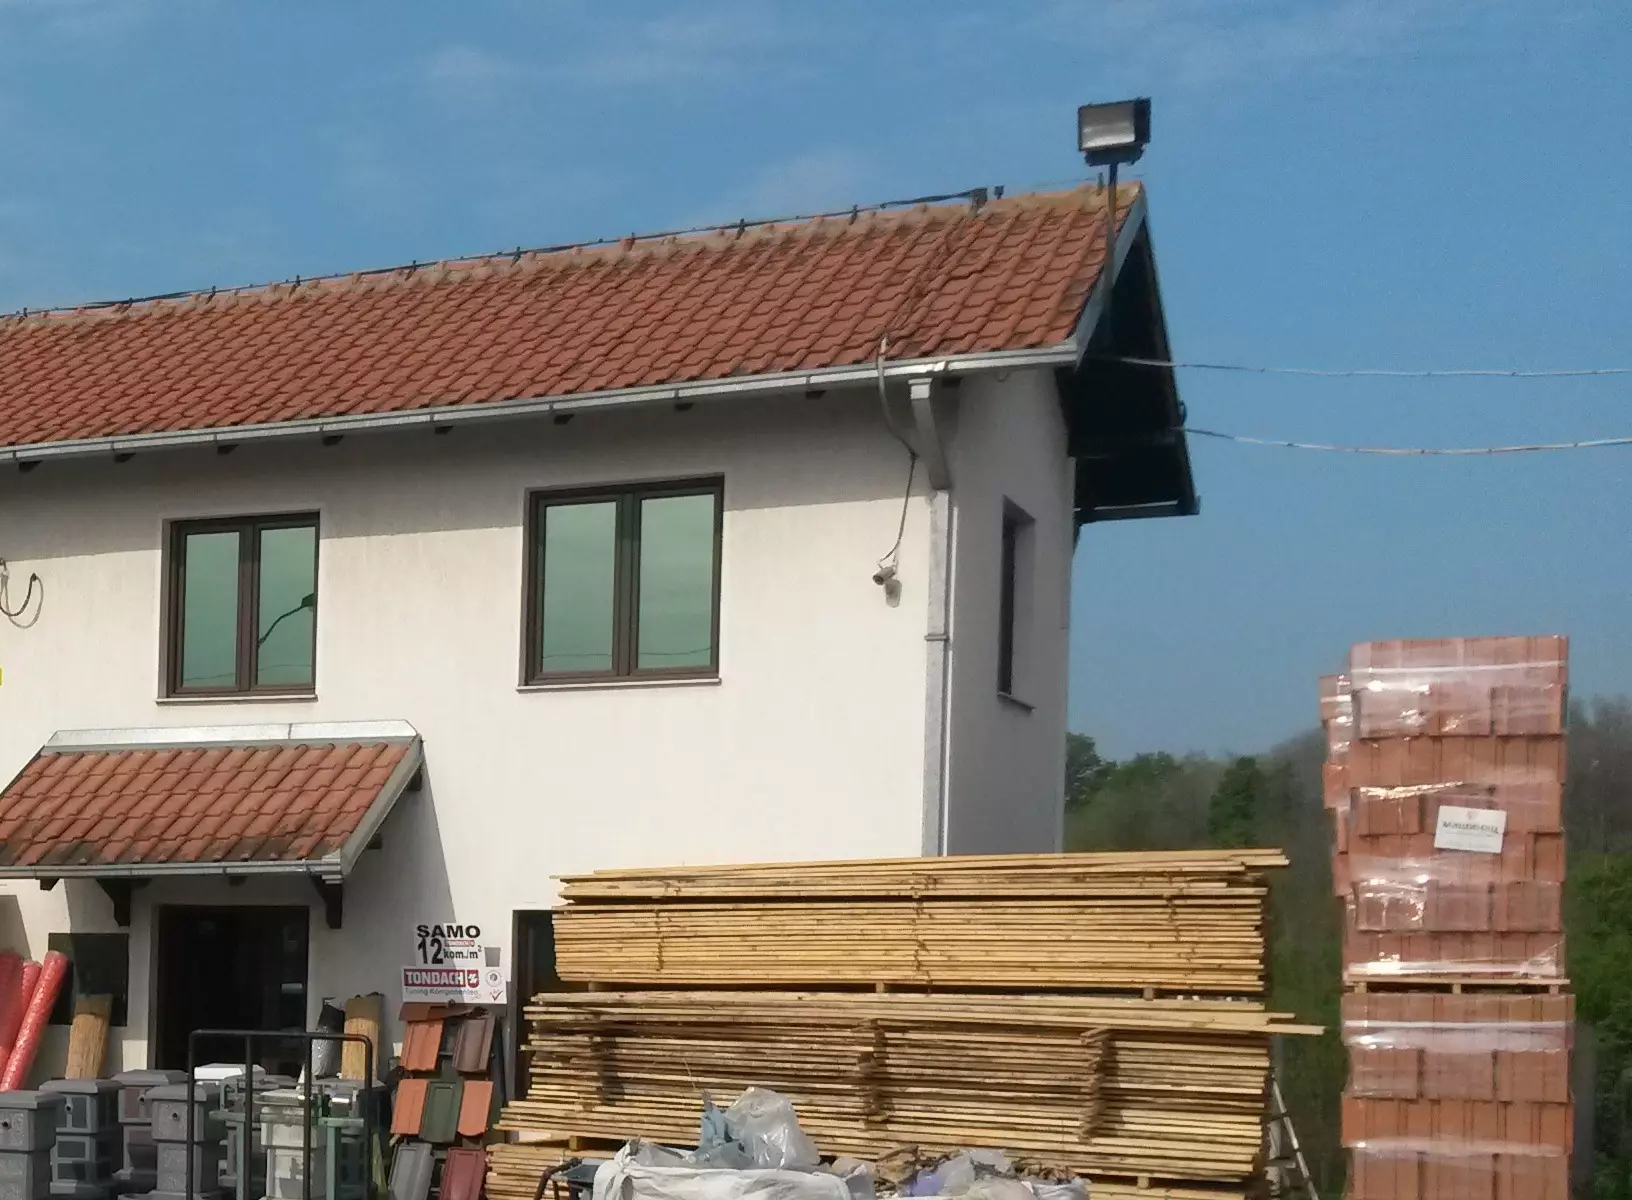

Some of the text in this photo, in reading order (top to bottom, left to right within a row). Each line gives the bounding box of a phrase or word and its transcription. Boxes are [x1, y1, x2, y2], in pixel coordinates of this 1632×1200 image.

[416, 925, 481, 938] SAMO
[417, 938, 444, 964] 12
[405, 971, 464, 985] TONDACH
